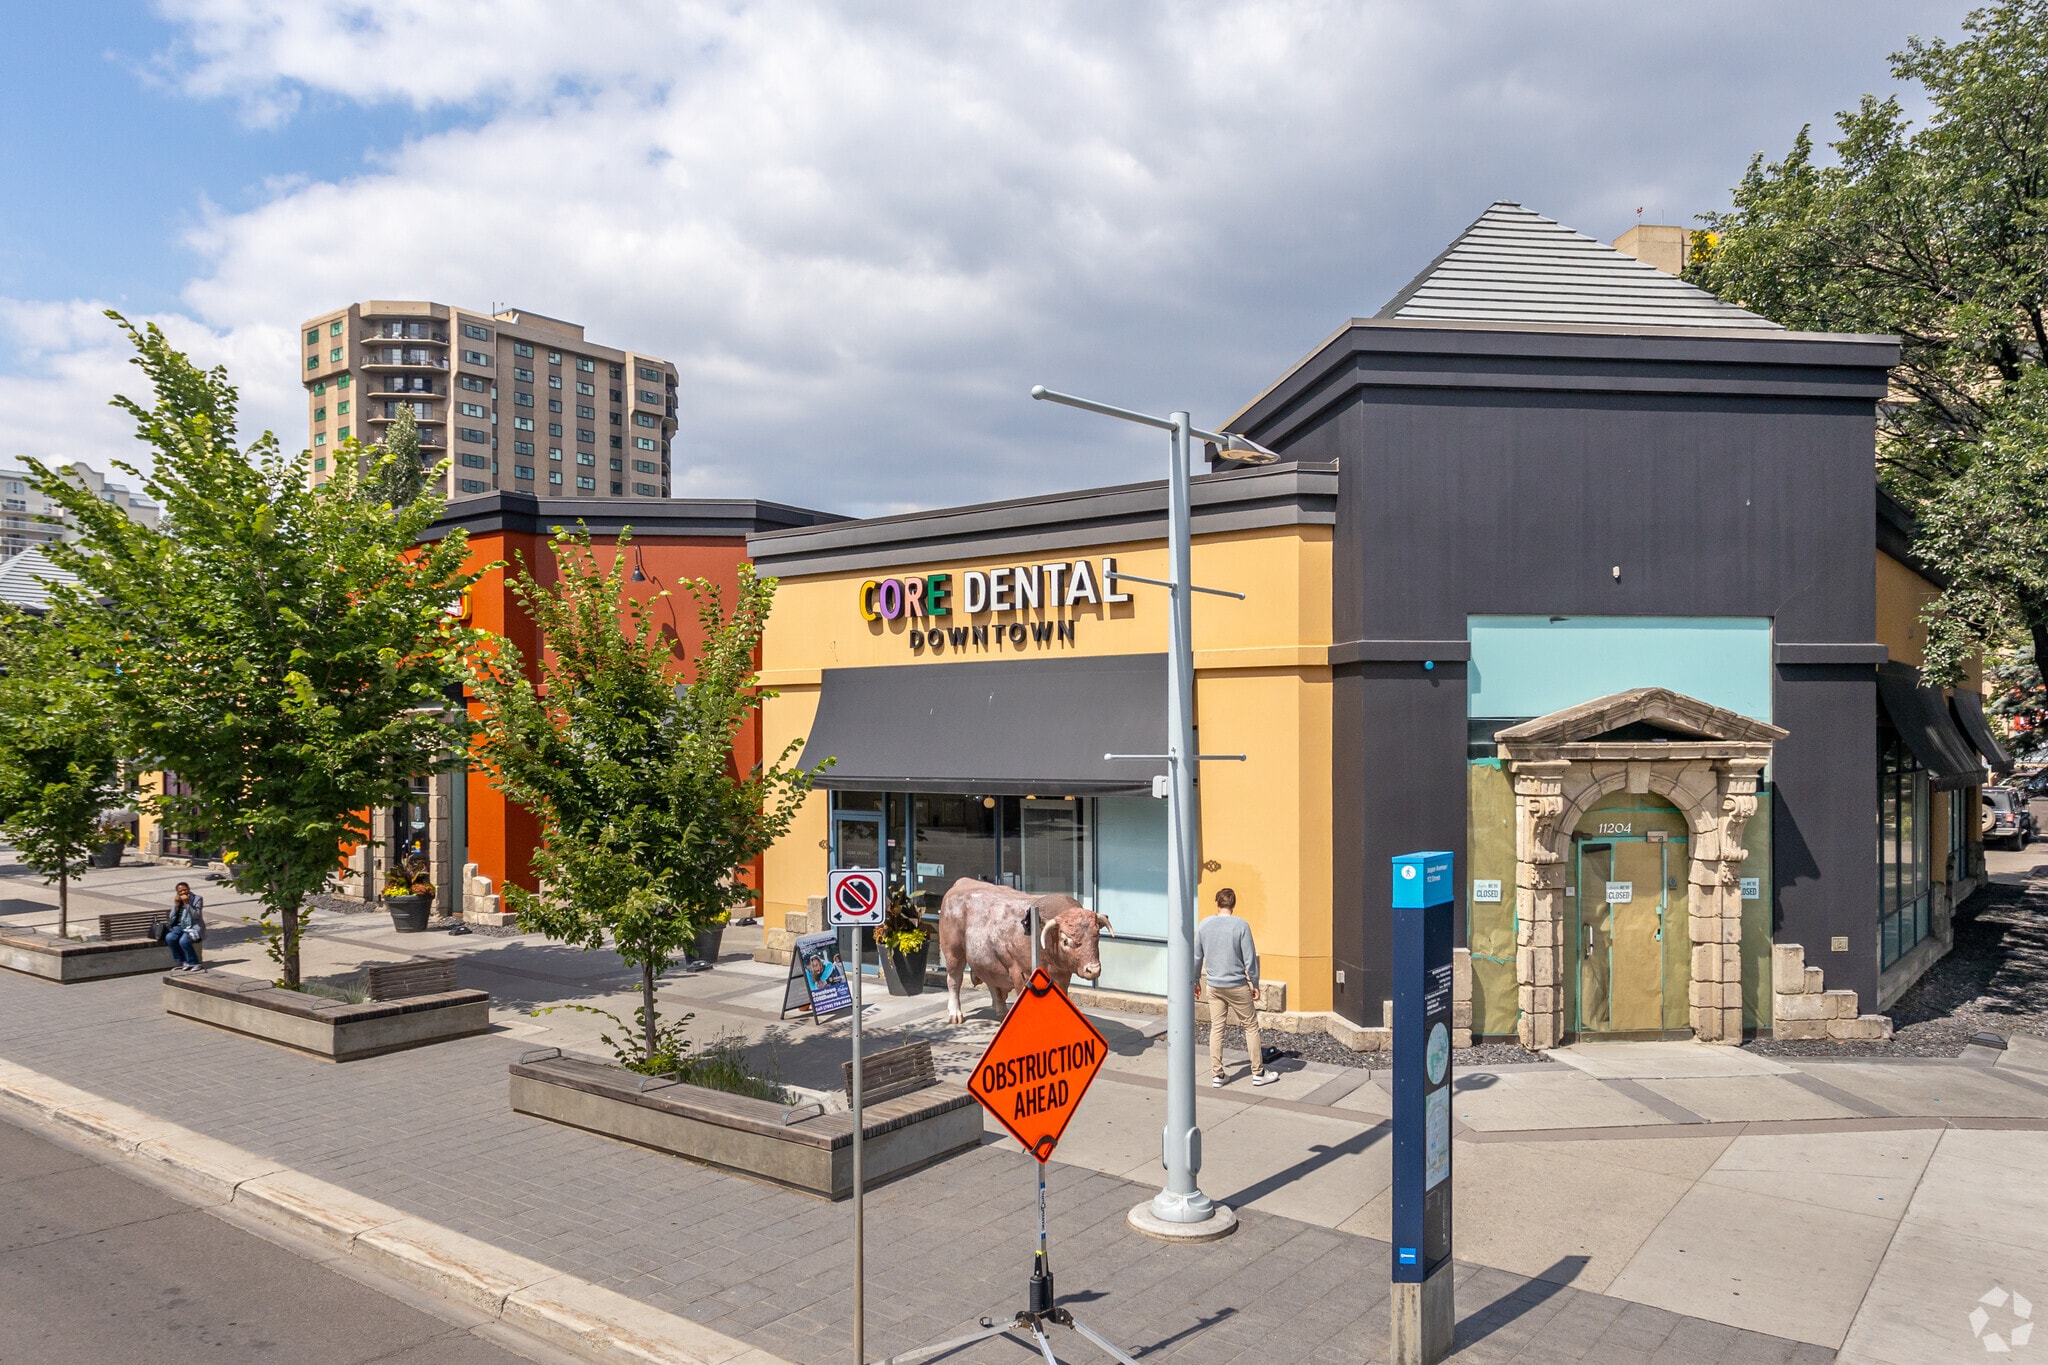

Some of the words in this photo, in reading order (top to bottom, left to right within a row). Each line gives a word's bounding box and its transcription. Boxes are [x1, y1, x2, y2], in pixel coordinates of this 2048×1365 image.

[859, 573, 952, 622] CORE
[964, 558, 1133, 614] DENTAL
[910, 619, 1075, 649] DOWNTOWN
[1598, 822, 1632, 834] 11204
[1476, 889, 1499, 898] CLOSED
[1608, 891, 1630, 900] CLOSED
[982, 1039, 1095, 1094] OBSTRUCTION
[1014, 1079, 1069, 1120] AHEAD
